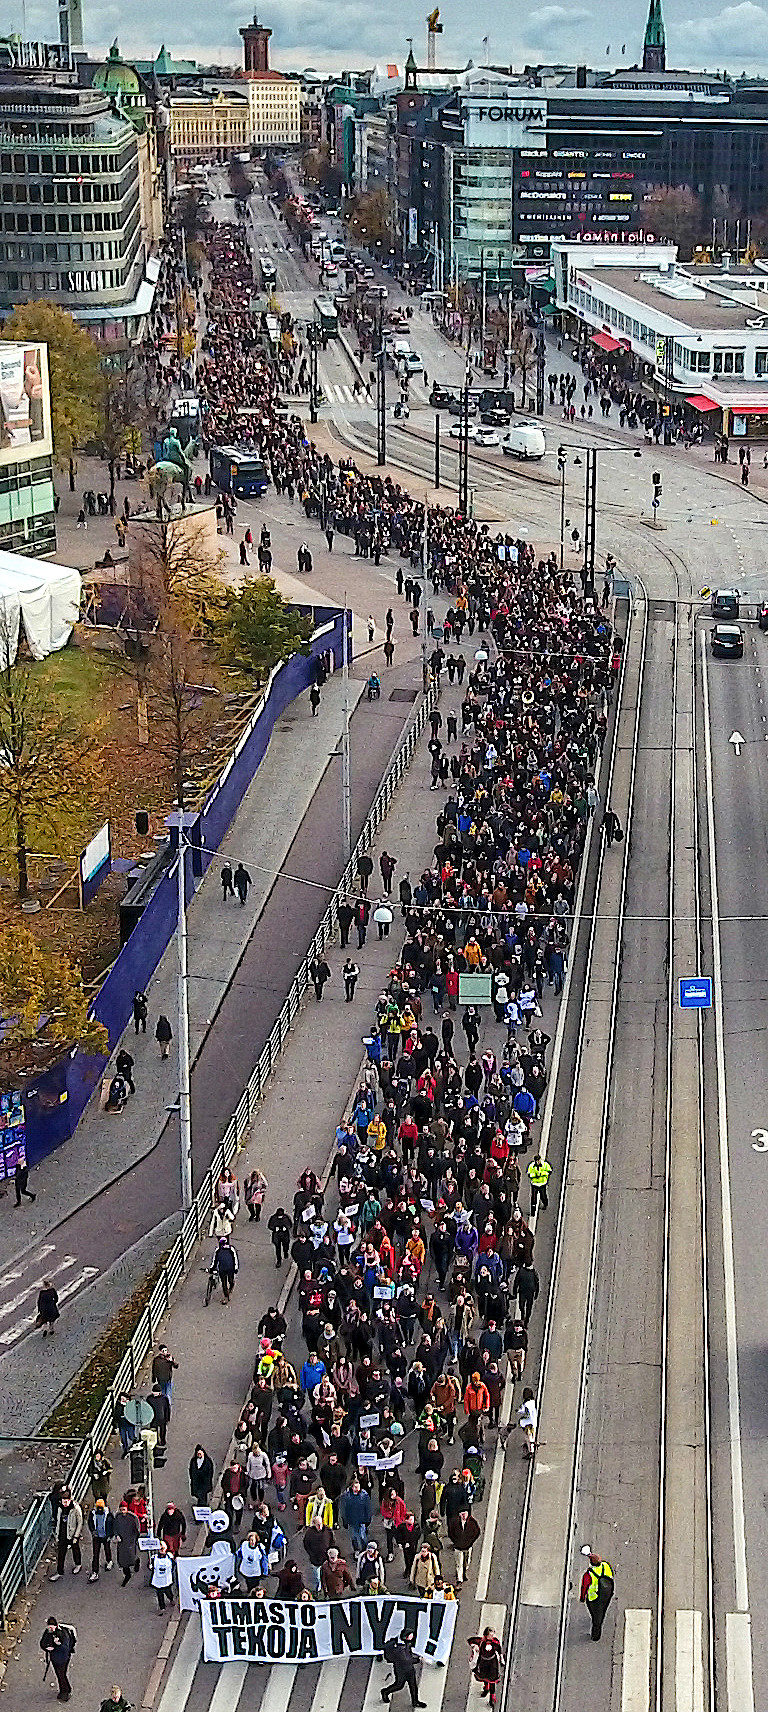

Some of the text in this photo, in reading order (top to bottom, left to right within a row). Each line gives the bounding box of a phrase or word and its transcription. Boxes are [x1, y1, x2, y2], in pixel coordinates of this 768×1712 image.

[478, 107, 544, 122] FORUM
[751, 1128, 768, 1152] 3
[210, 1600, 447, 1657] ILMASTO- NYT!
[213, 1625, 319, 1660] TEKOJA
